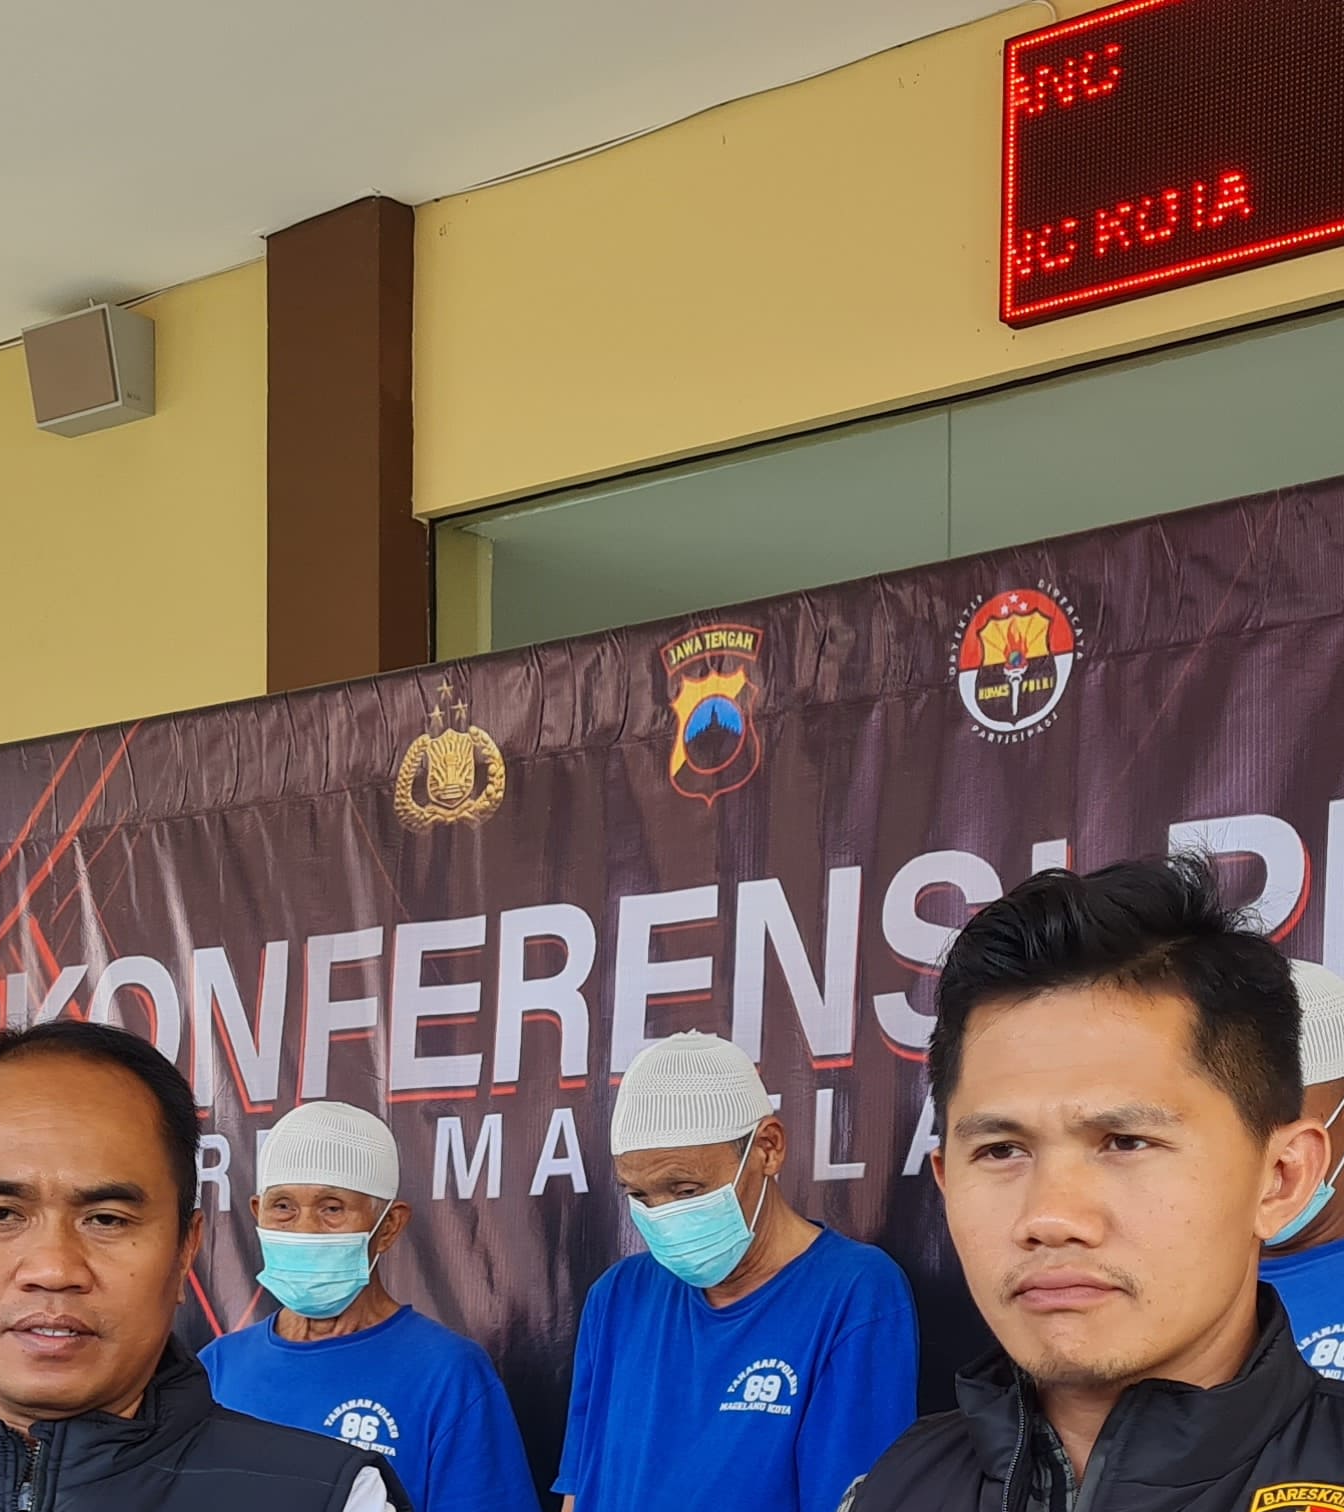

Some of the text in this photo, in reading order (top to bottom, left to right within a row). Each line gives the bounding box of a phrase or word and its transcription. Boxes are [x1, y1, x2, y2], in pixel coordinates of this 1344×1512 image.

[669, 630, 754, 665] JAWA TENGAH
[971, 710, 1059, 745] PARTISIPASI
[7, 838, 1068, 1107] ONFERENS
[432, 1083, 942, 1200] MALA
[727, 1358, 777, 1392] TAHANAN
[743, 1375, 782, 1402] 89
[323, 1399, 373, 1427] TAHANAN
[341, 1412, 380, 1442] 86
